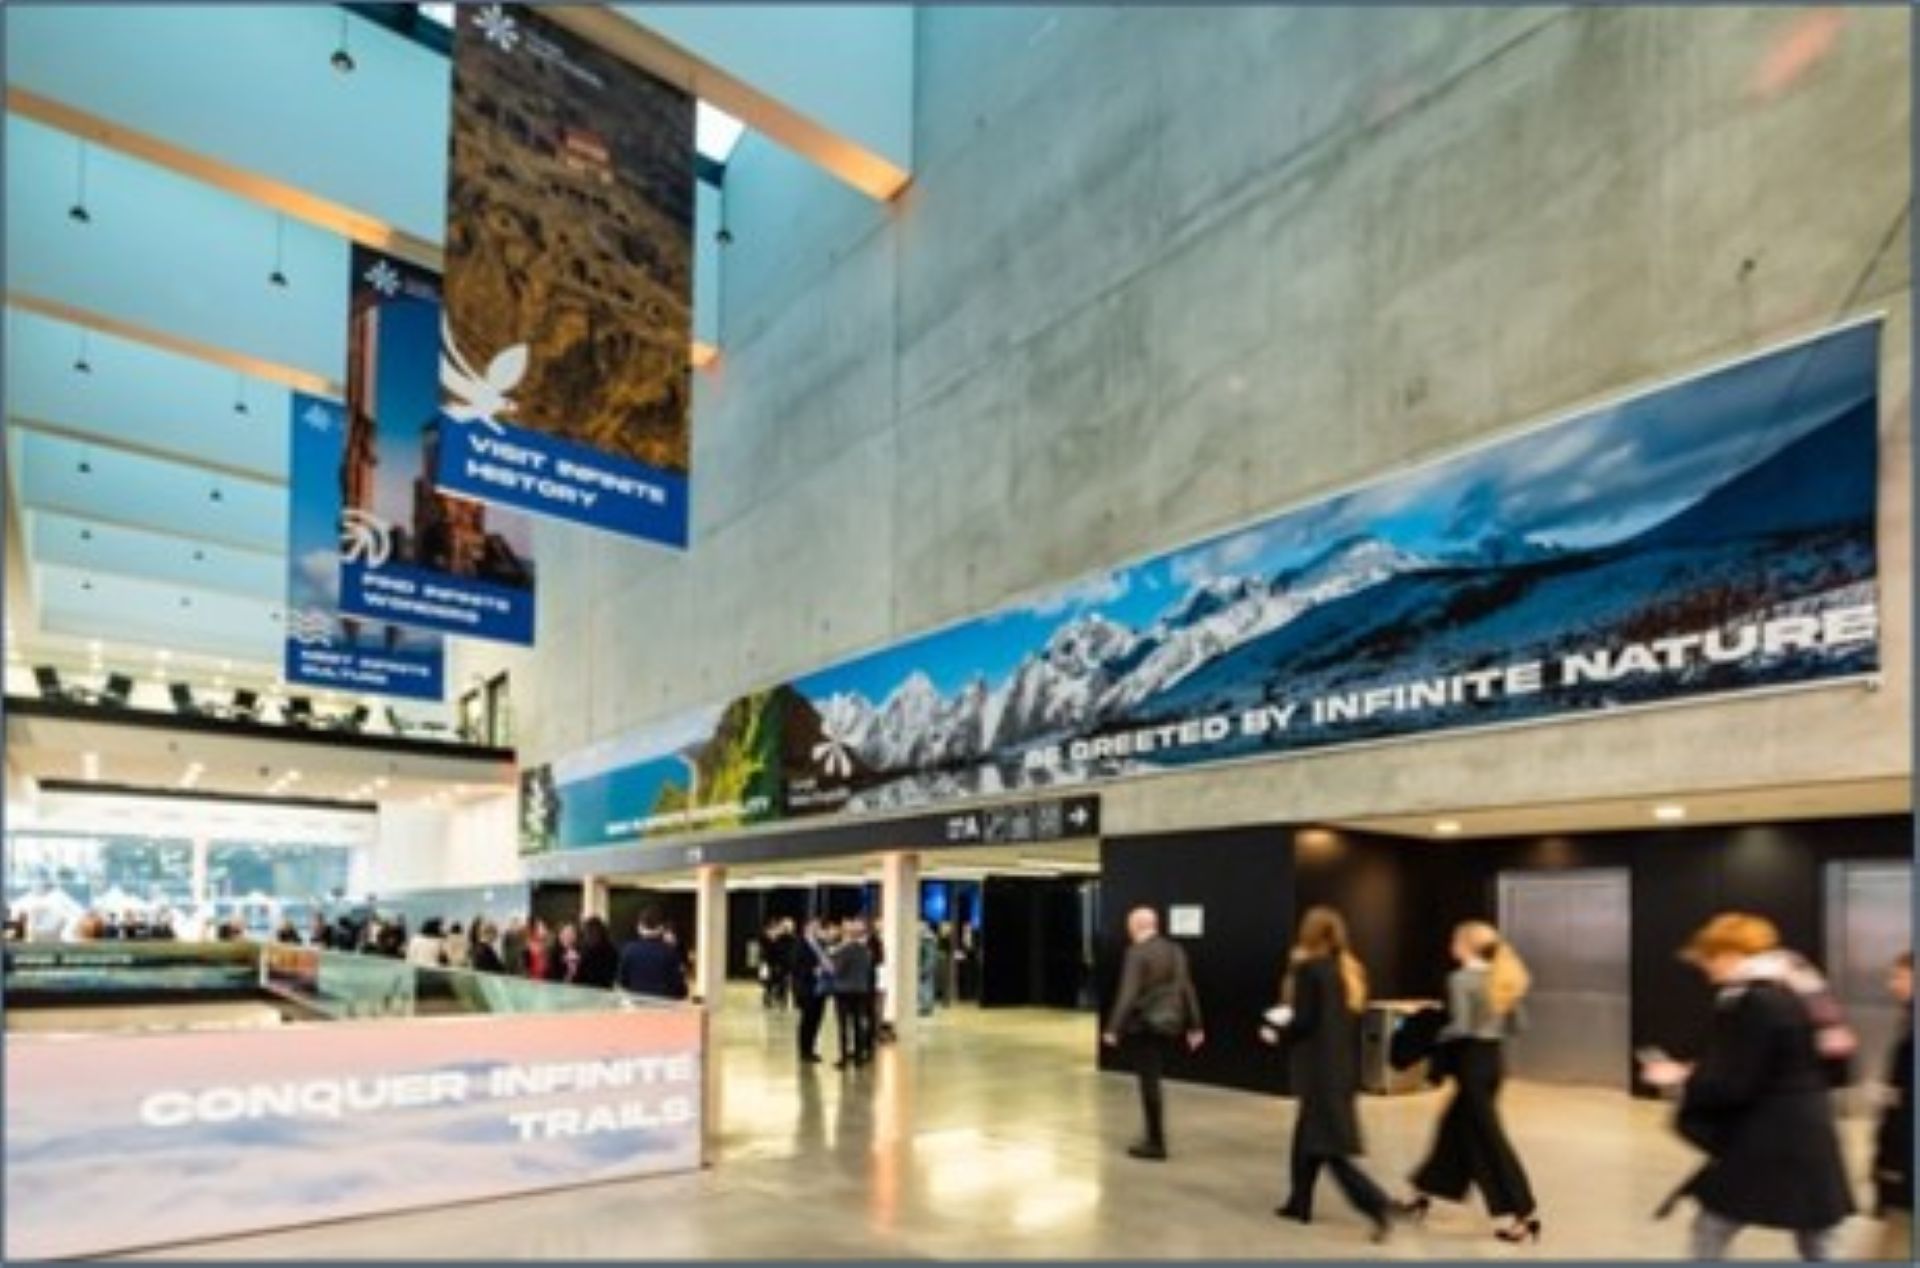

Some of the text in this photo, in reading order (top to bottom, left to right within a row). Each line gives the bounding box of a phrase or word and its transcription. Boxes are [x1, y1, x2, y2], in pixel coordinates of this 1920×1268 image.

[468, 434, 547, 470] VISIT
[466, 458, 597, 509] HISTORY
[1069, 714, 1231, 762] GREETED
[1241, 701, 1298, 737] BY
[1311, 660, 1543, 727] INFINITE
[1561, 603, 1876, 688] NATURE
[140, 1053, 693, 1128] CONQUER INFINITE
[508, 1096, 695, 1141] TRAILS
